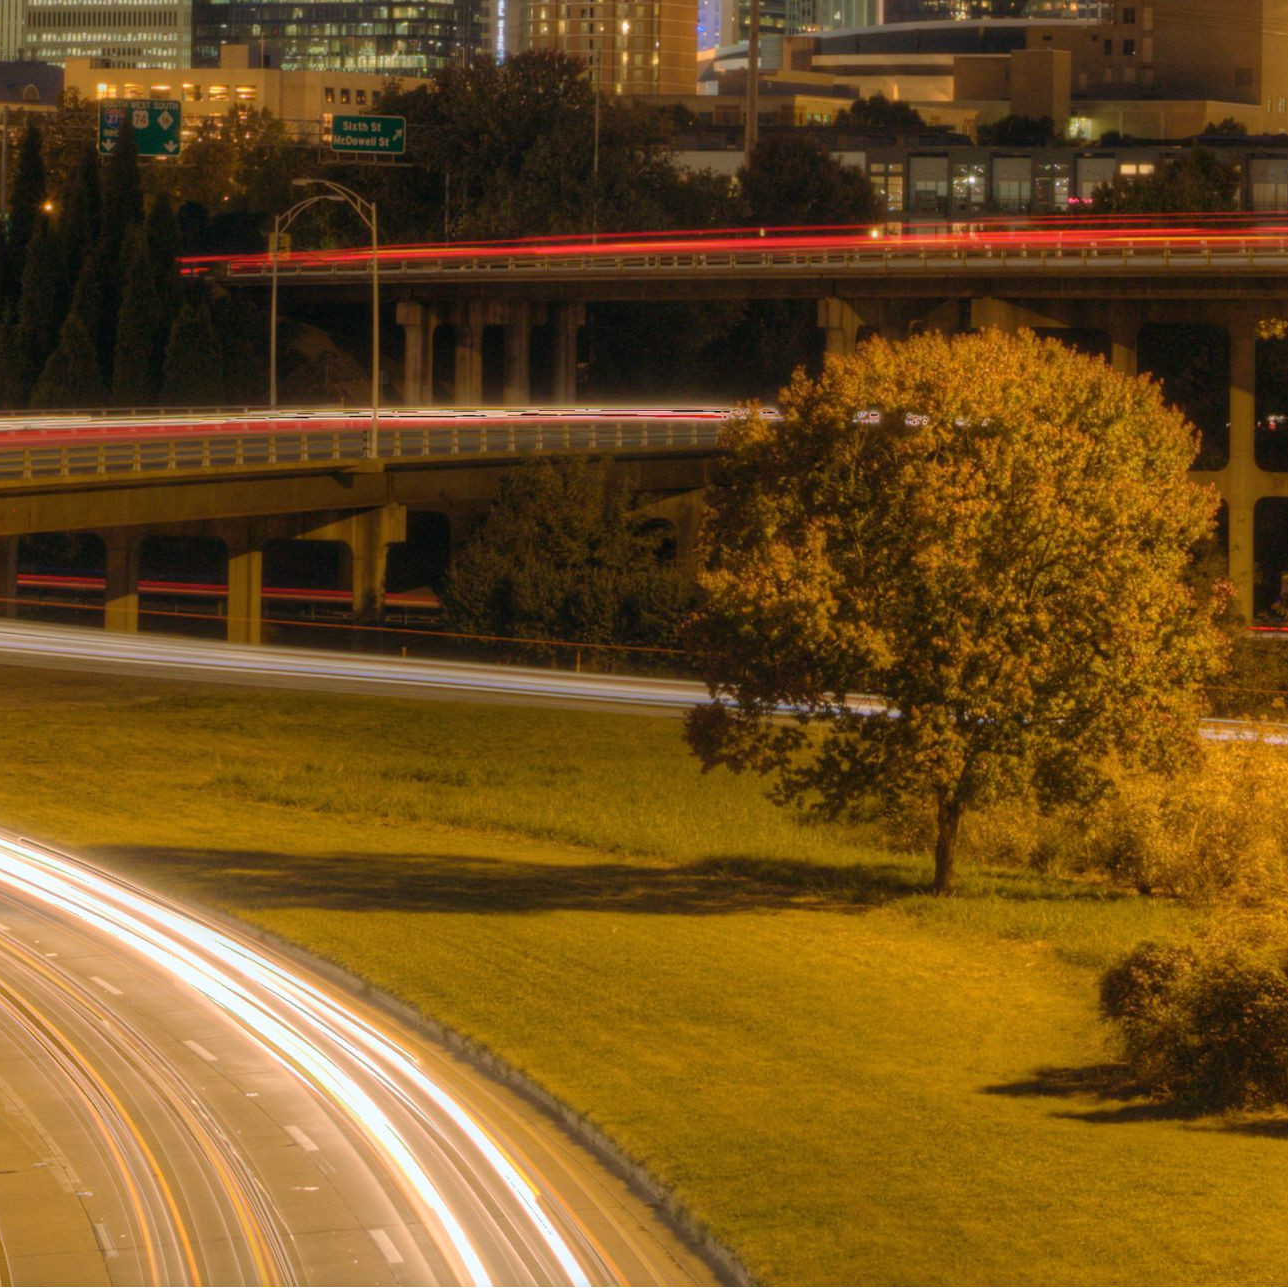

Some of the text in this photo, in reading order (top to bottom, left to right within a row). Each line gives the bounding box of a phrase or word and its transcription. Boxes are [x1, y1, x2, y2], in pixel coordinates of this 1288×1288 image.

[131, 101, 150, 109] WEST
[154, 102, 179, 110] SOUTH
[135, 113, 147, 124] 74
[342, 120, 382, 132] Sixth St
[333, 135, 389, 147] McDowell St
